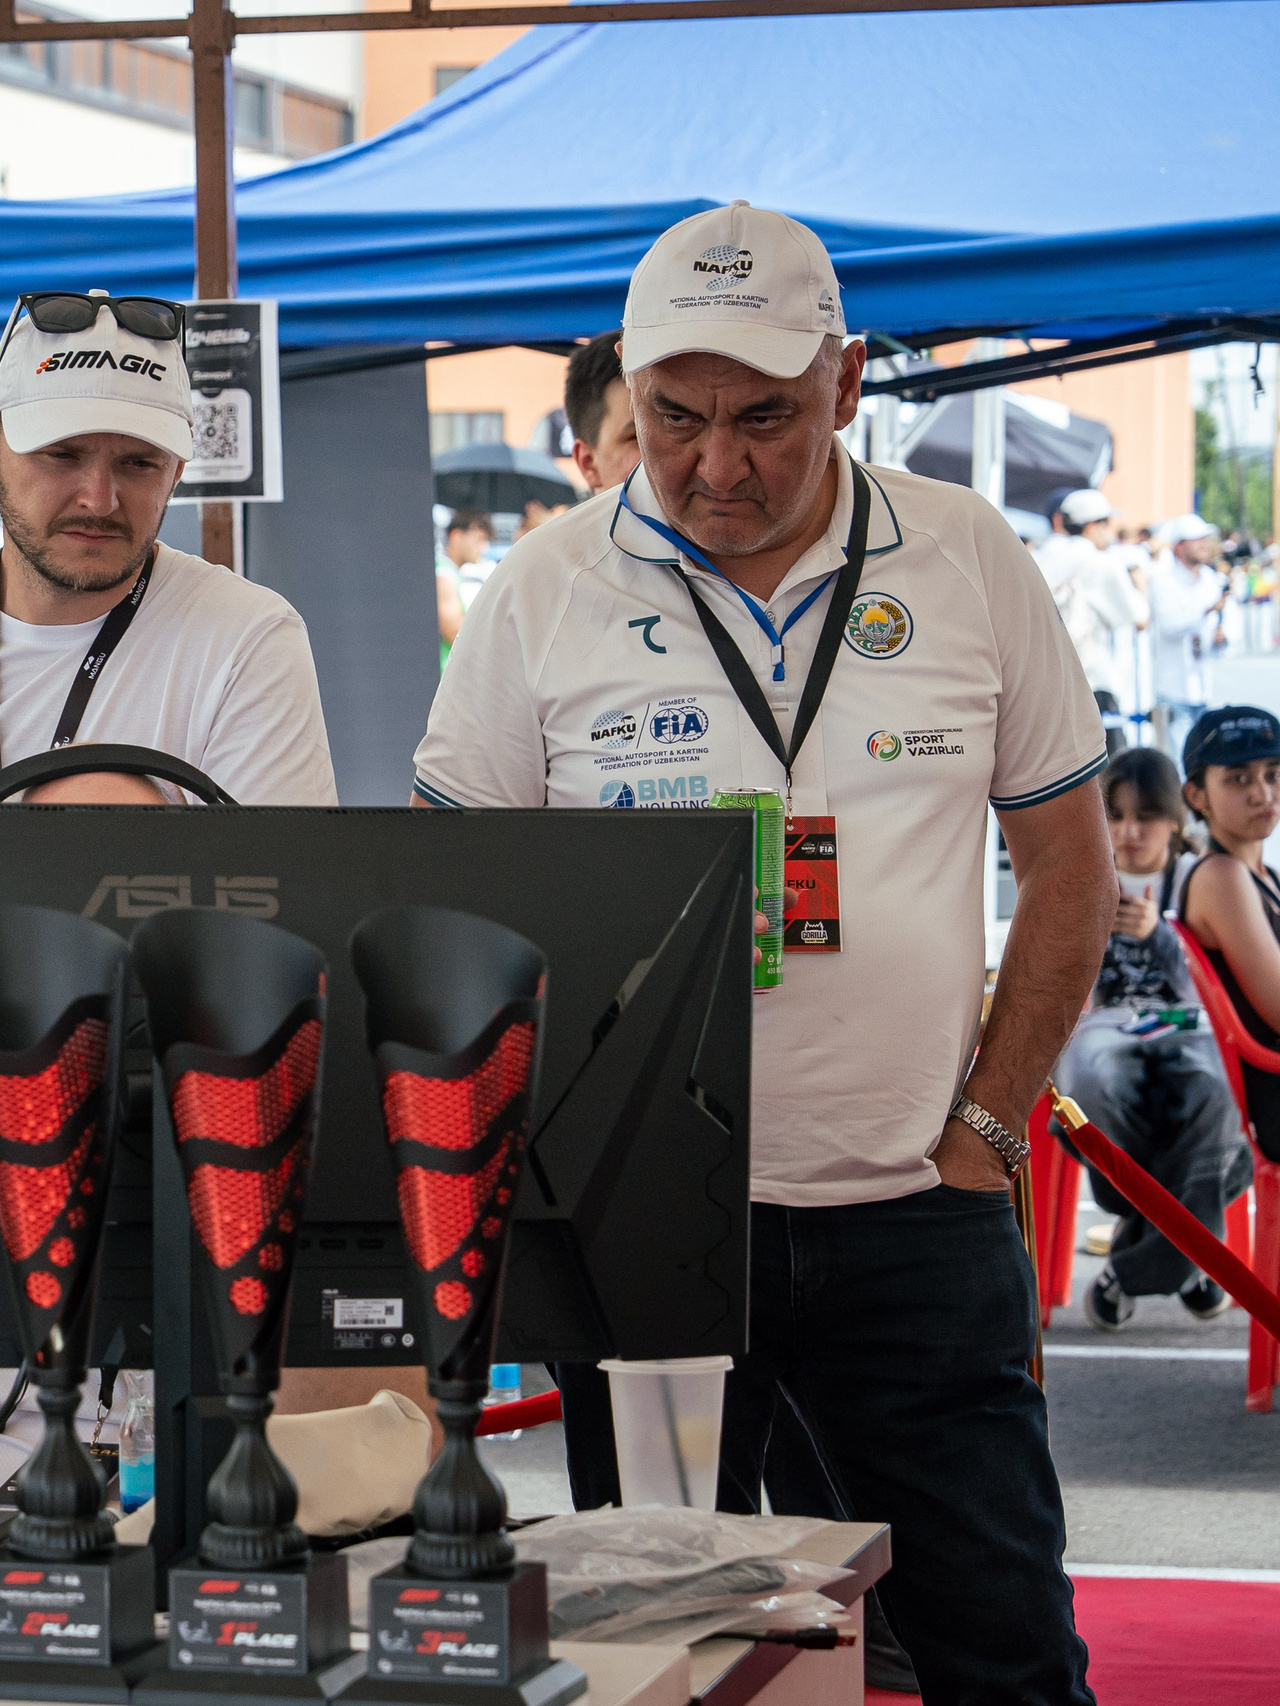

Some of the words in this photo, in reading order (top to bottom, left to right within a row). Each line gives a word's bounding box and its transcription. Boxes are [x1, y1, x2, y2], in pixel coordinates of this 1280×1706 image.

[693, 260, 754, 275] NAFKU
[669, 295, 697, 304] NATIONAL
[698, 293, 735, 301] AUTOSPORT
[741, 294, 769, 304] KARTING
[674, 301, 711, 309] FEDERATION
[723, 301, 762, 309] UZBEKISTAN
[44, 350, 167, 382] SIMAGIC
[131, 577, 147, 606] MANGU
[88, 652, 107, 680] MANGU
[658, 698, 686, 707] MEMBER
[590, 722, 637, 742] NAFKU
[904, 735, 945, 746] SPORT
[593, 755, 623, 765] NATIONAL
[624, 751, 668, 761] AUTOSPORT
[676, 747, 709, 756] KARTING
[907, 745, 965, 757] VAZIRLIGI
[600, 761, 641, 771] FEDERATION
[642, 758, 653, 766] OF
[654, 756, 700, 765] UZBEKISTAN
[637, 775, 709, 801] BMB
[82, 875, 280, 919] ASUS
[802, 930, 827, 939] GORILLA
[41, 1622, 101, 1639] PLACE
[233, 1632, 298, 1649] PLACE
[437, 1641, 500, 1659] PLACE
